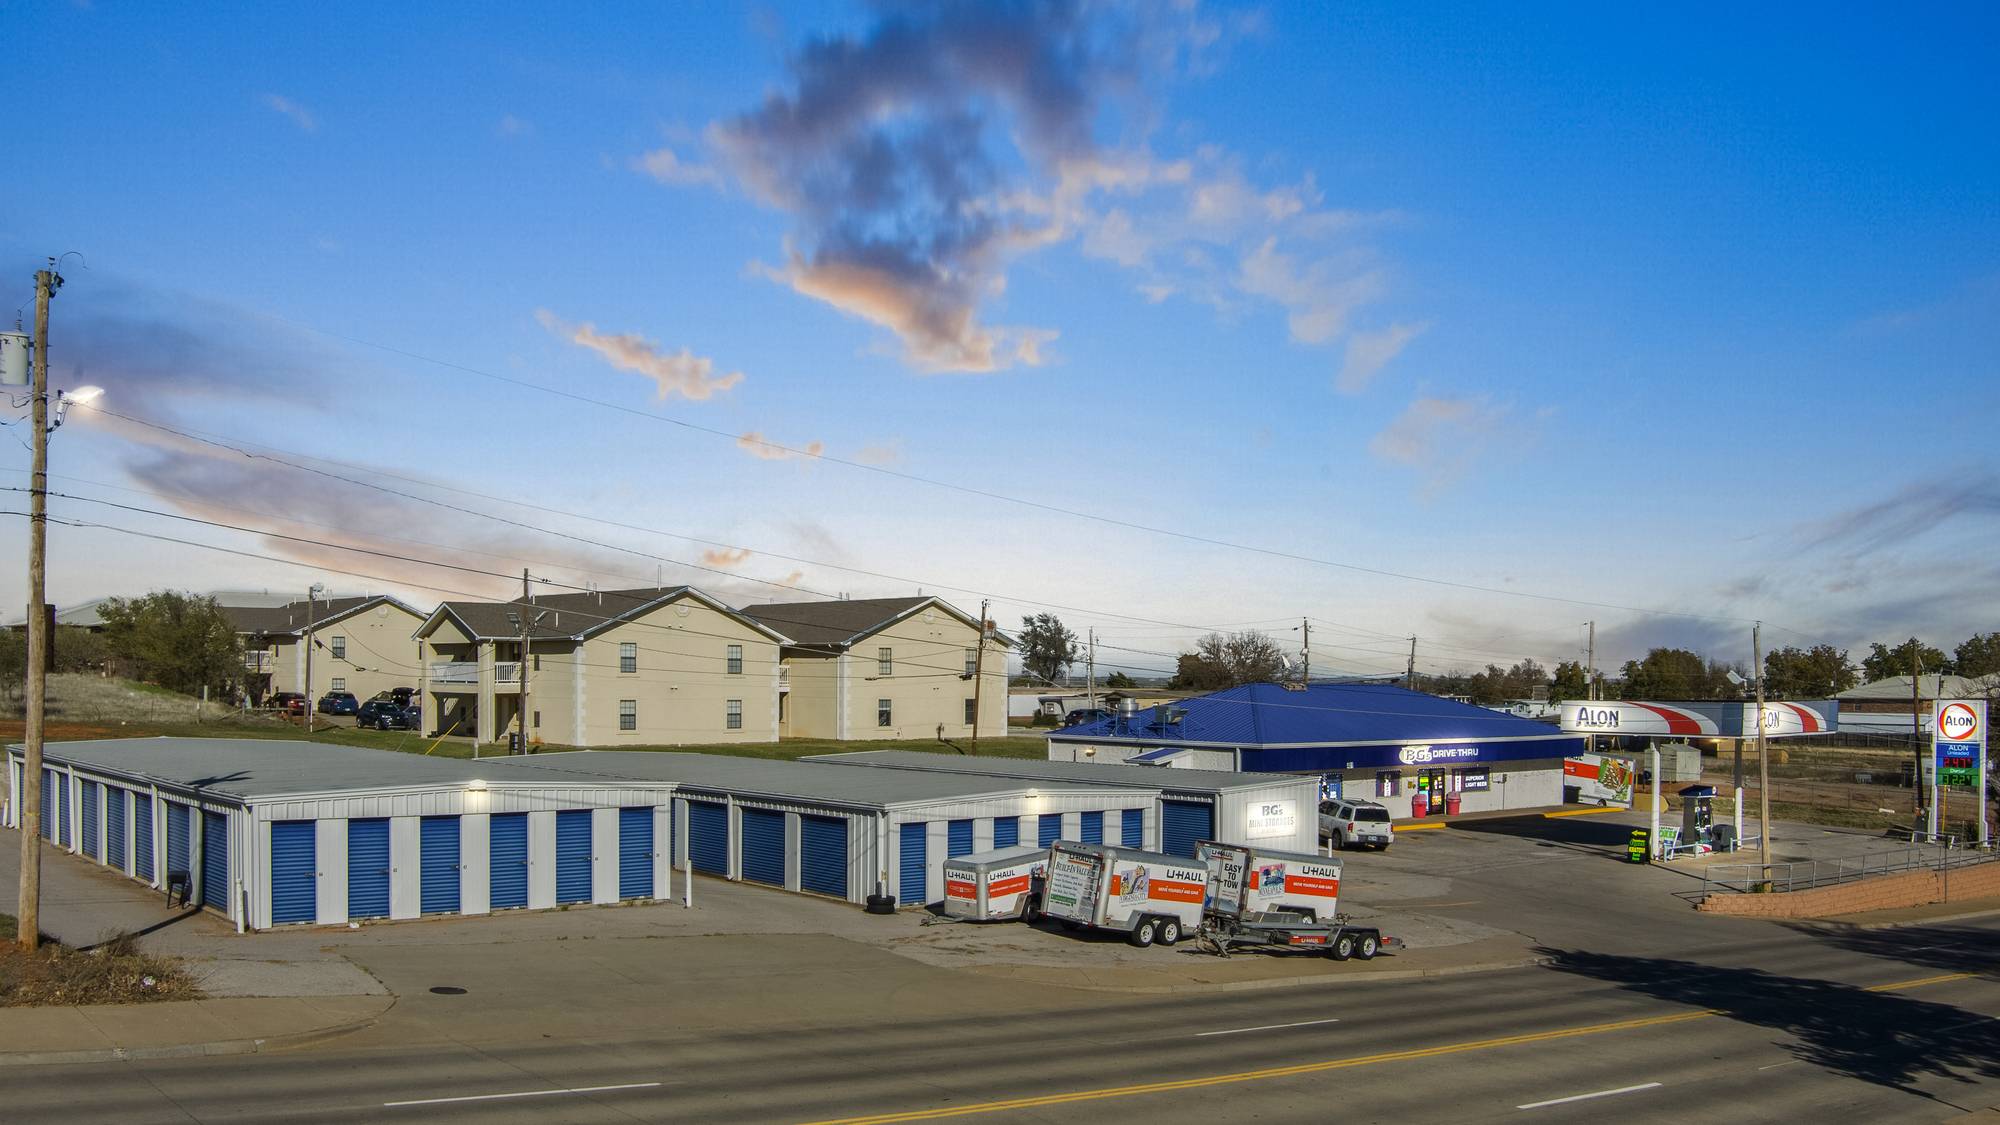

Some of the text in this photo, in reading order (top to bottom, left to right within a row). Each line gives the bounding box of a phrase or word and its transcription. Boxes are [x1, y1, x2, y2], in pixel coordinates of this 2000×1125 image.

[1577, 706, 1619, 726] ALON
[1945, 715, 1973, 726] ALON
[1432, 748, 1479, 758] DRIVE-THRU
[1948, 744, 1969, 752] ALON
[1224, 863, 1242, 873] EASY
[1302, 866, 1337, 878] U-HAUL
[947, 871, 976, 881] U-HAUL
[989, 869, 1016, 881] U-HAUL
[1166, 869, 1204, 882] U-HAUL
[1227, 872, 1237, 881] TO
[1223, 880, 1239, 889] TOW
